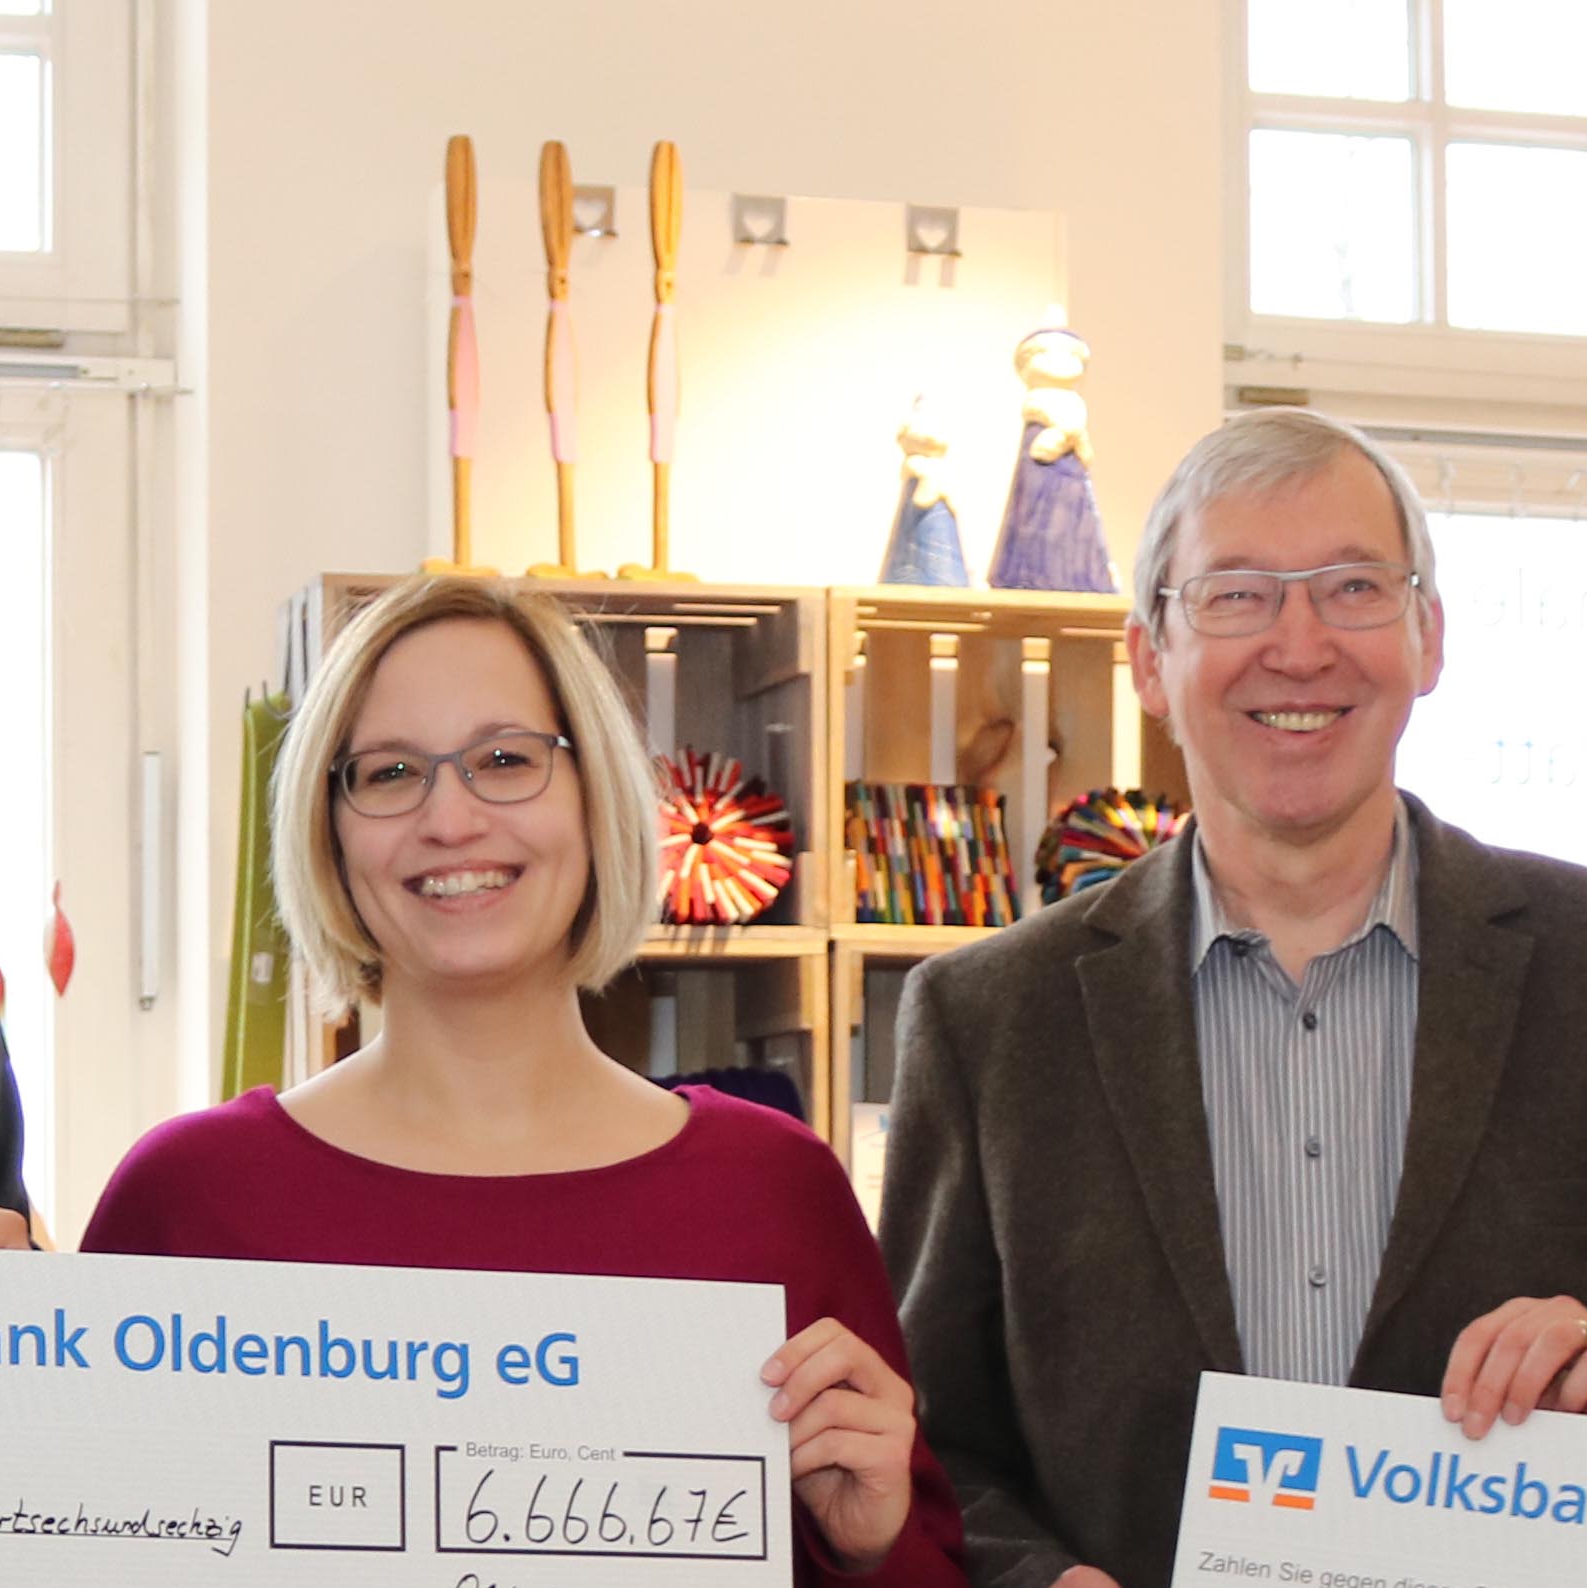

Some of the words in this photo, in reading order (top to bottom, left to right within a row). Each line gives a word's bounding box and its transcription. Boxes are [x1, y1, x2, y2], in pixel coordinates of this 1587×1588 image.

[114, 1313, 470, 1398] Oldenburg
[496, 1332, 580, 1387] eG
[465, 1442, 525, 1462] Betrag:
[529, 1444, 572, 1463] Euro,
[577, 1445, 616, 1462] Cent
[308, 1485, 368, 1508] EUR
[1198, 1552, 1271, 1578] Zahlen
[1278, 1563, 1313, 1584] Sie
